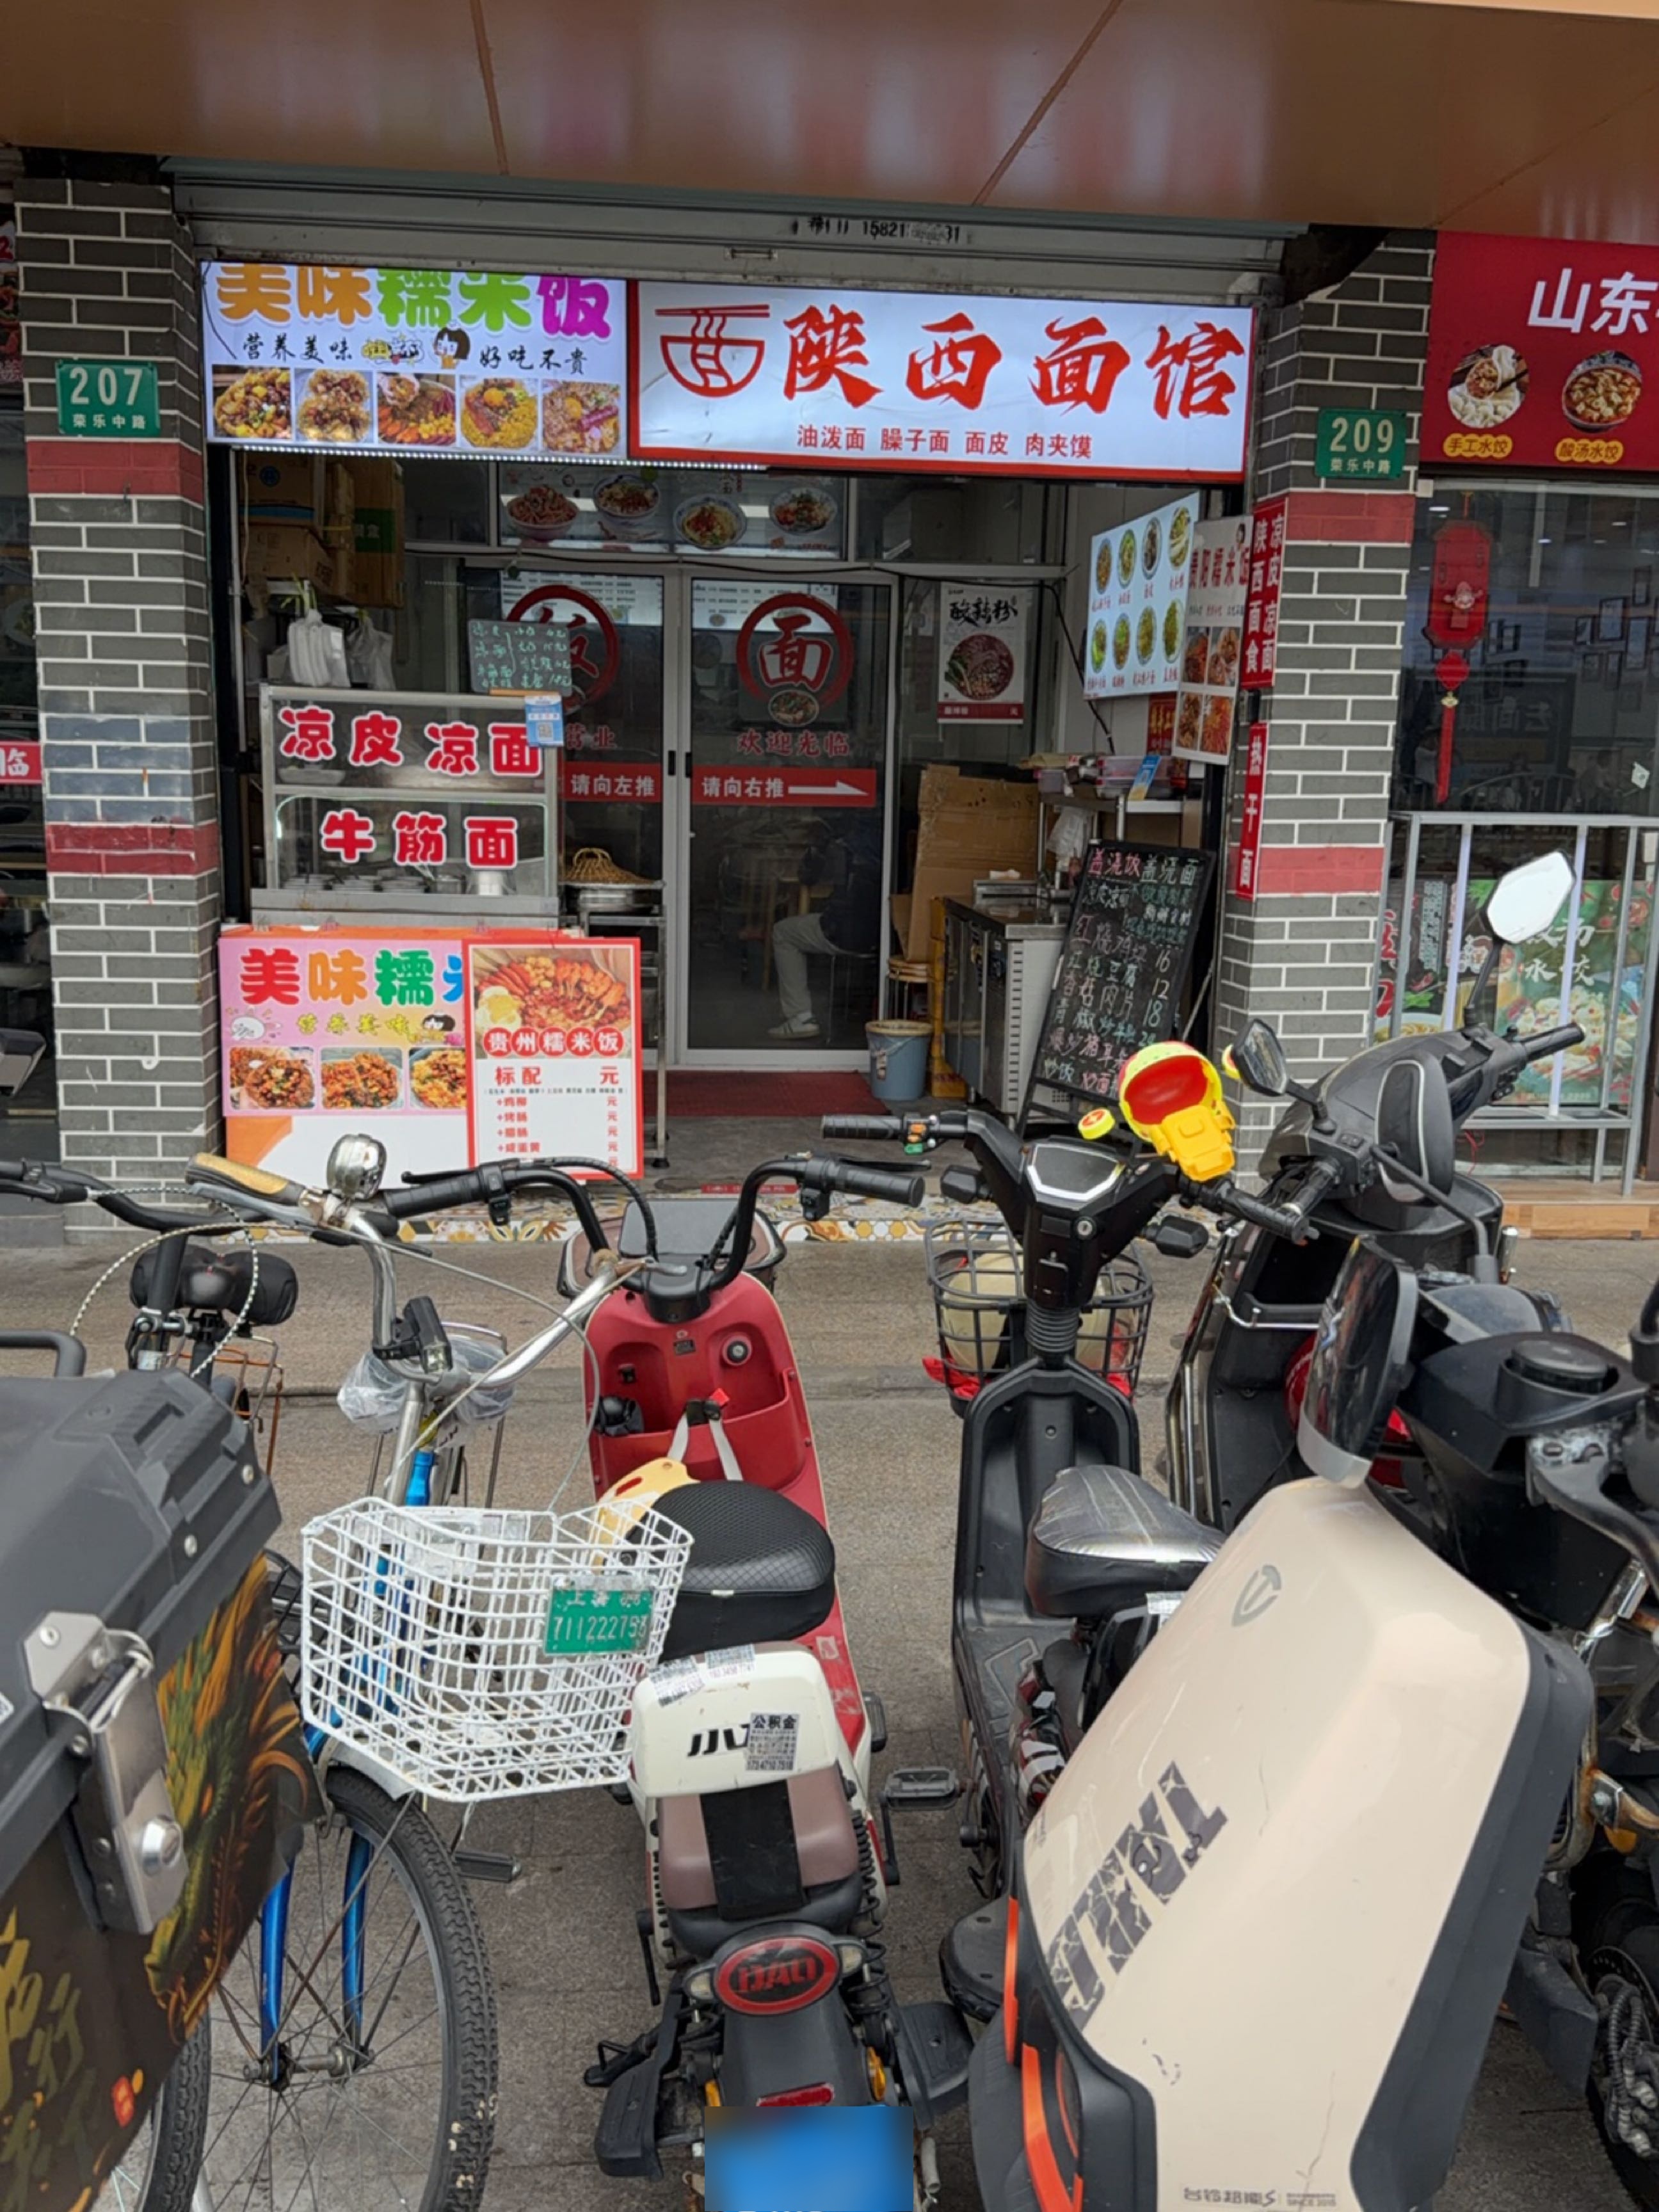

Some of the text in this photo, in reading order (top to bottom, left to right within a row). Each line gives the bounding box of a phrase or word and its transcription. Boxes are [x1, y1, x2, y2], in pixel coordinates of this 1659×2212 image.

[216, 262, 611, 339] 美味糯米饭
[1527, 268, 1659, 335] 山东
[243, 333, 353, 362] 营养美味
[782, 303, 1245, 420] 陕西面馆
[69, 367, 143, 406] 207
[797, 424, 1093, 459] 油泼面 臊子面 面皮 肉夹馍
[1330, 417, 1393, 453] 209
[1448, 438, 1508, 454] 手工水饺
[758, 613, 833, 691] 面
[737, 731, 852, 758] 欢迎光临
[570, 773, 657, 797] 请向左推
[701, 776, 785, 799] 请向右推
[321, 808, 517, 869] 牛筋面
[1151, 977, 1170, 1000] 12
[1143, 998, 1163, 1028] 18
[488, 1030, 619, 1054] 贵州糯米饭
[495, 1065, 620, 1086] 标配 元
[752, 1715, 796, 1729] 公积金
